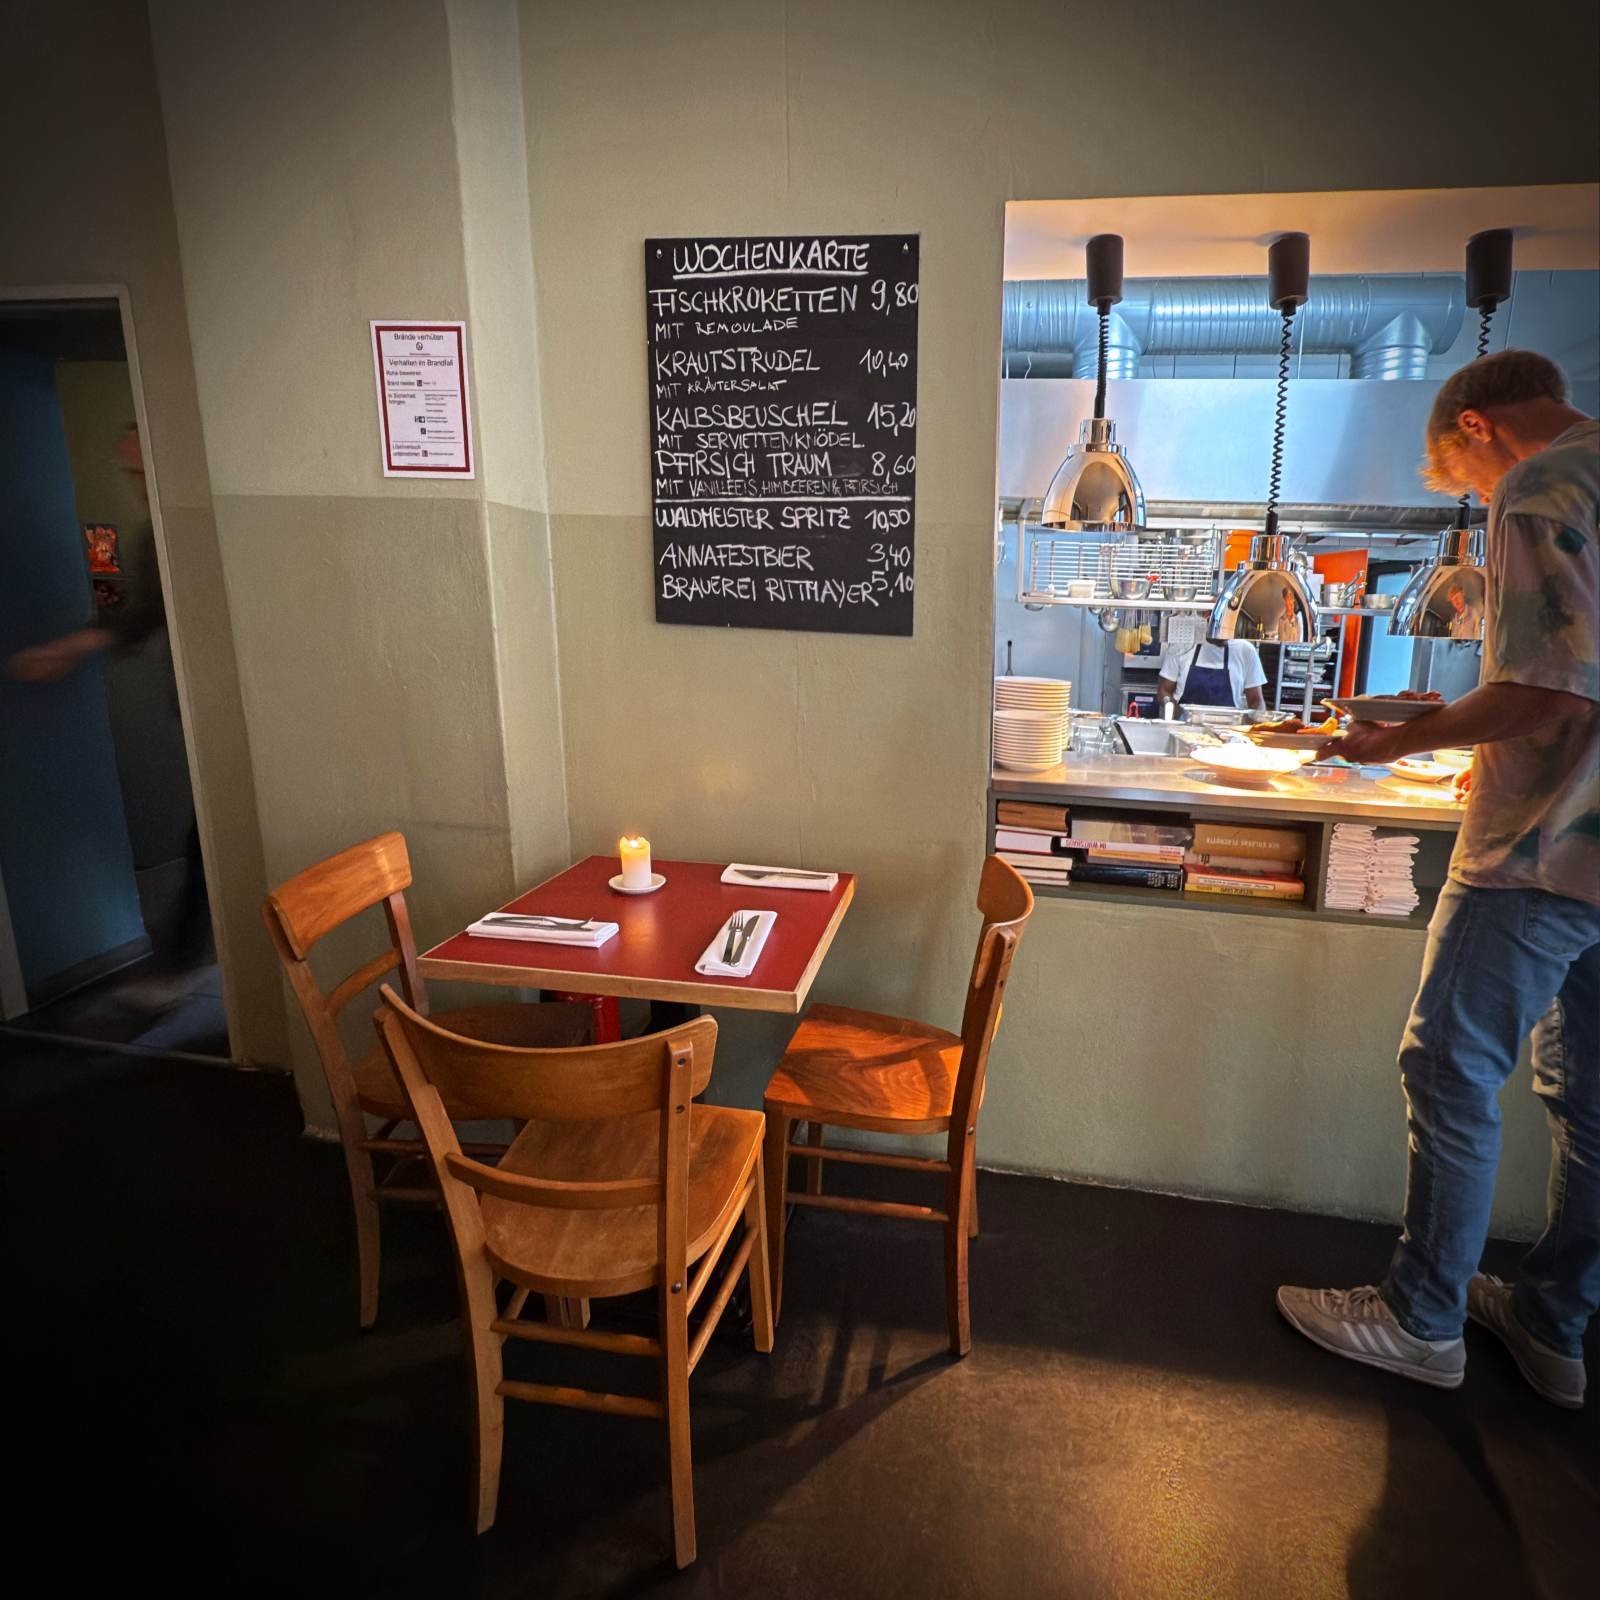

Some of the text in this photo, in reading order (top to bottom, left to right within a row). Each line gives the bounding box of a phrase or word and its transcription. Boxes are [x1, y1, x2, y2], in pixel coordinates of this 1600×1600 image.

[673, 240, 870, 272] WOCHENKARTE
[649, 280, 918, 317] FISCHKROKETTEN 9,80
[656, 317, 798, 342] MIT REMOULADE
[656, 347, 908, 380] KRAUTSTRUDEL 10,40
[657, 376, 787, 399] MIT KRÄUTERSALAT
[657, 401, 916, 436] KALBSBEUSCHEL 15,20
[658, 434, 682, 449] MIT
[655, 450, 916, 484] PFIRSICH TRAUM 8,60
[656, 478, 684, 496] MIT
[656, 506, 910, 533] WALDMEISTER SPRITZ 10,50
[660, 543, 911, 571] ANNAFESTBIER 3,40
[662, 571, 914, 608] BRAUEREI RITTMAYER 5,10
